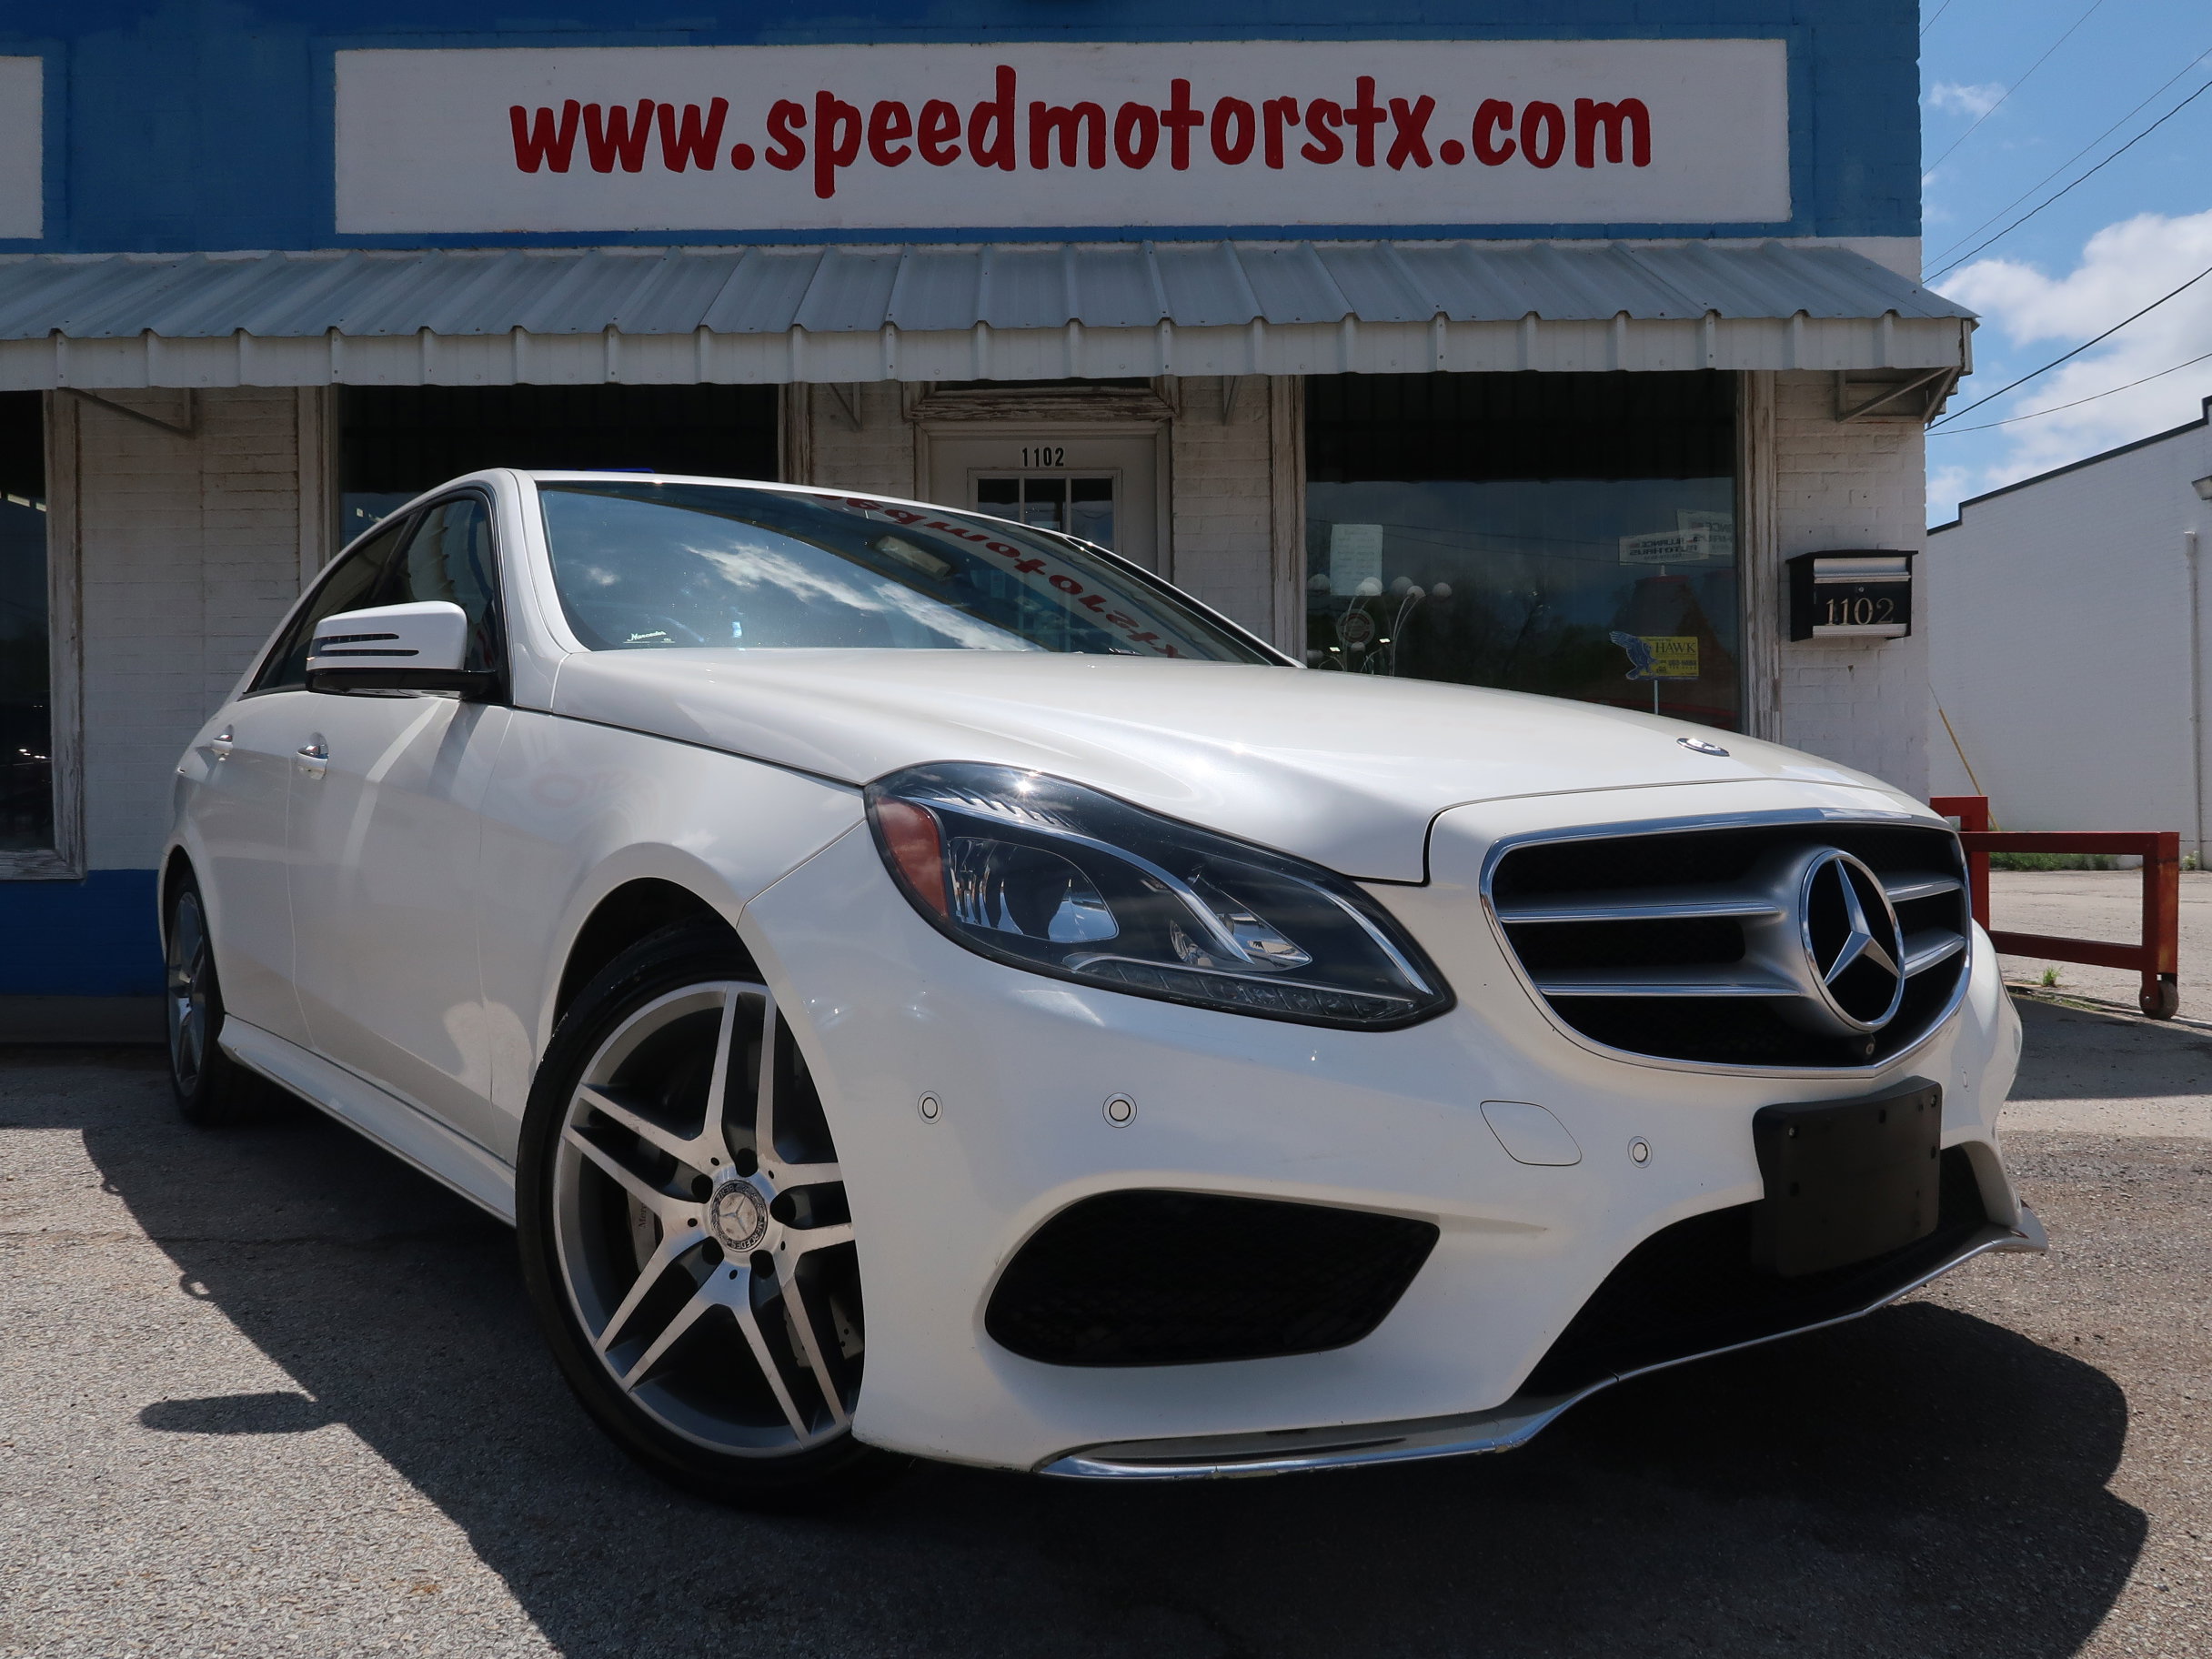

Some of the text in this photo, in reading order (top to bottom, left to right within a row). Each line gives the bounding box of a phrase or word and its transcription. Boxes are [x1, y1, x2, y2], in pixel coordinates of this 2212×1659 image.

[512, 65, 1649, 197] www.speedmotorstx.com
[1021, 447, 1065, 468] 1102
[1825, 597, 1895, 627] 1102
[1655, 642, 1696, 653] HAWK
